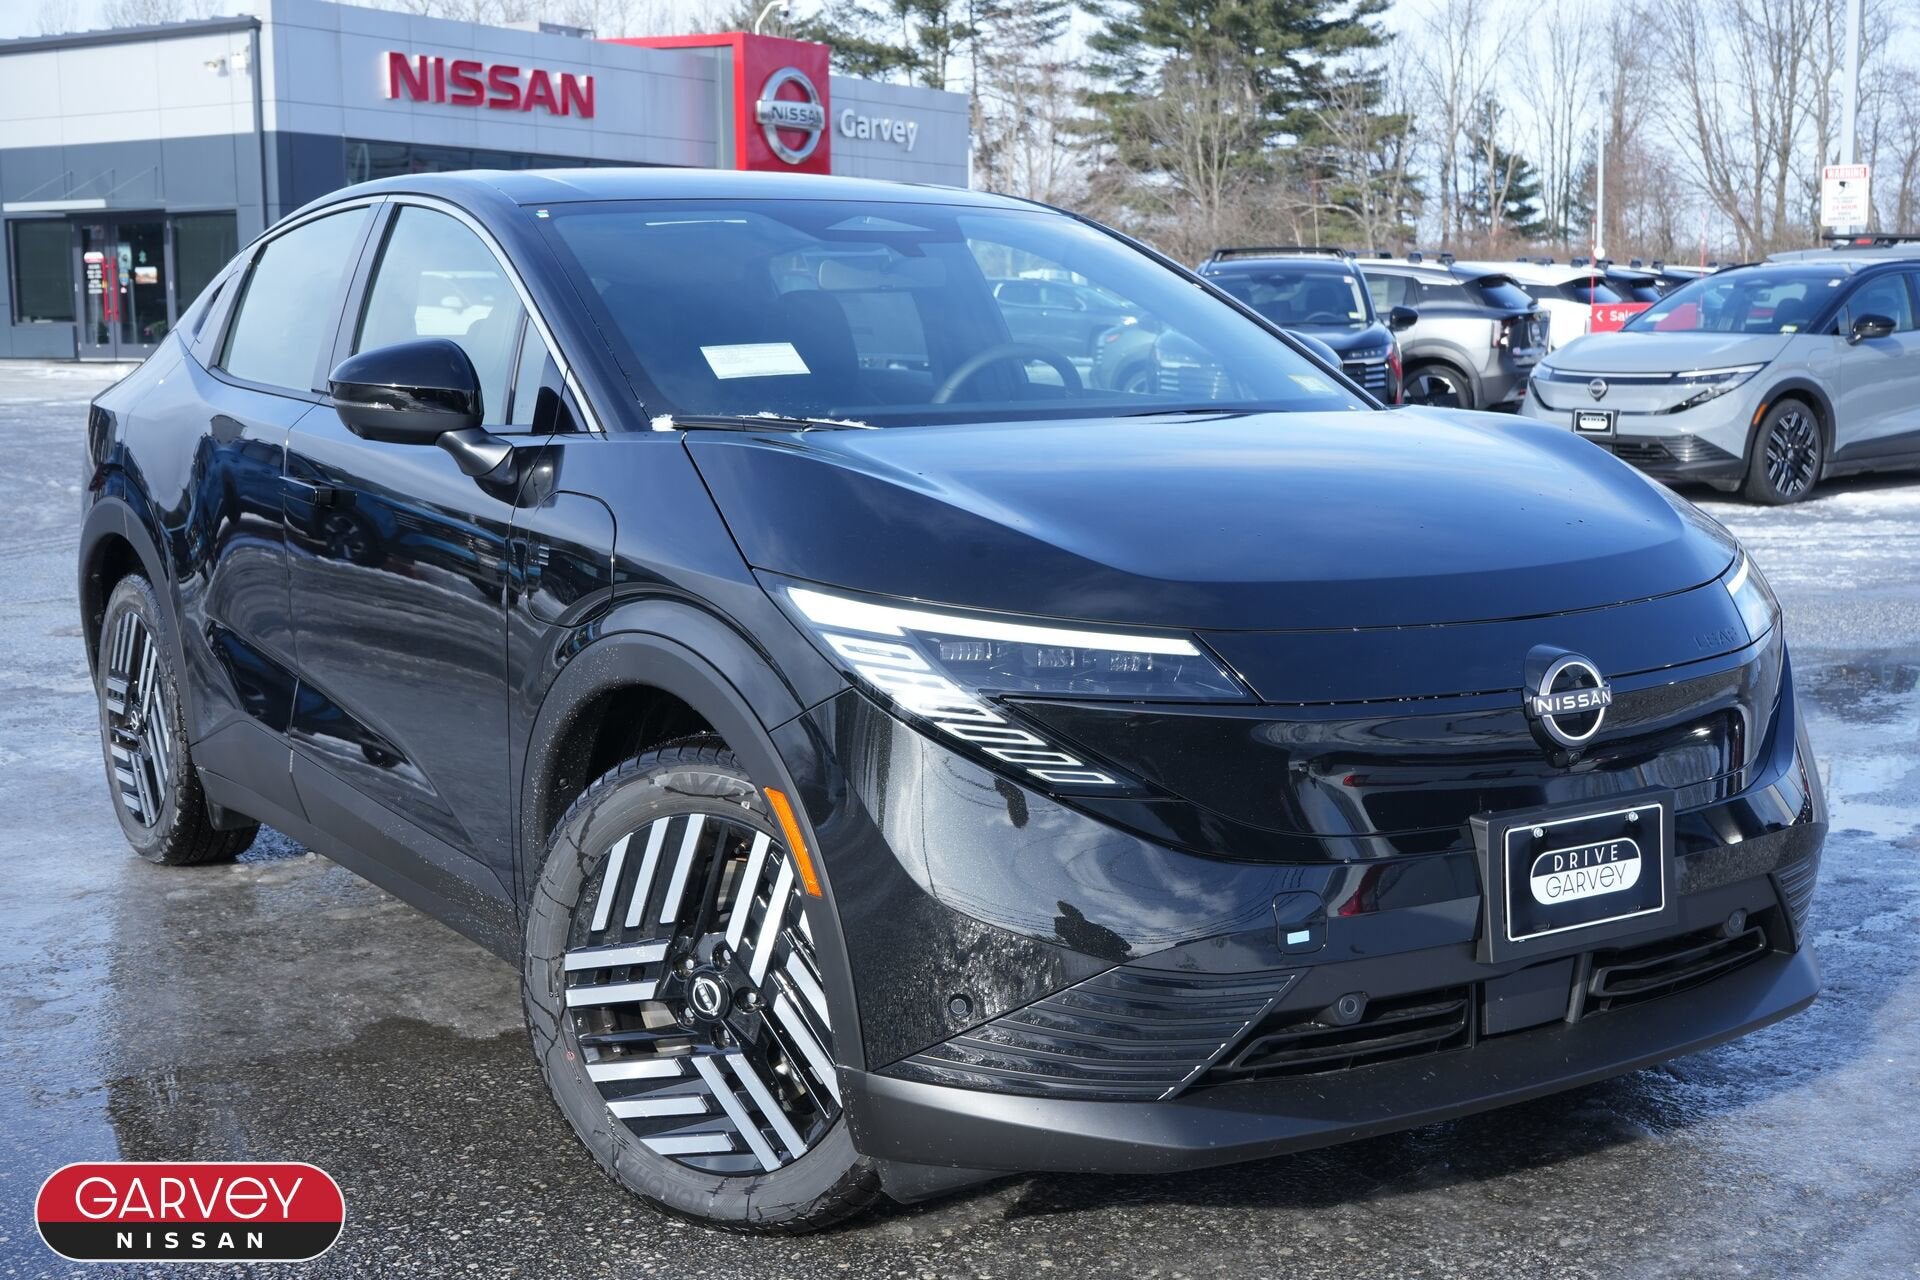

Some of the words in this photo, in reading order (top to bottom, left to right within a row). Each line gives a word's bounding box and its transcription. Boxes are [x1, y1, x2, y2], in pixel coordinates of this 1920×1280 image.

[386, 51, 594, 118] NISSAN
[771, 105, 822, 127] NISSAN
[840, 108, 918, 151] Garvey
[1537, 690, 1611, 713] NISSAN
[1554, 844, 1618, 871] DRIVE
